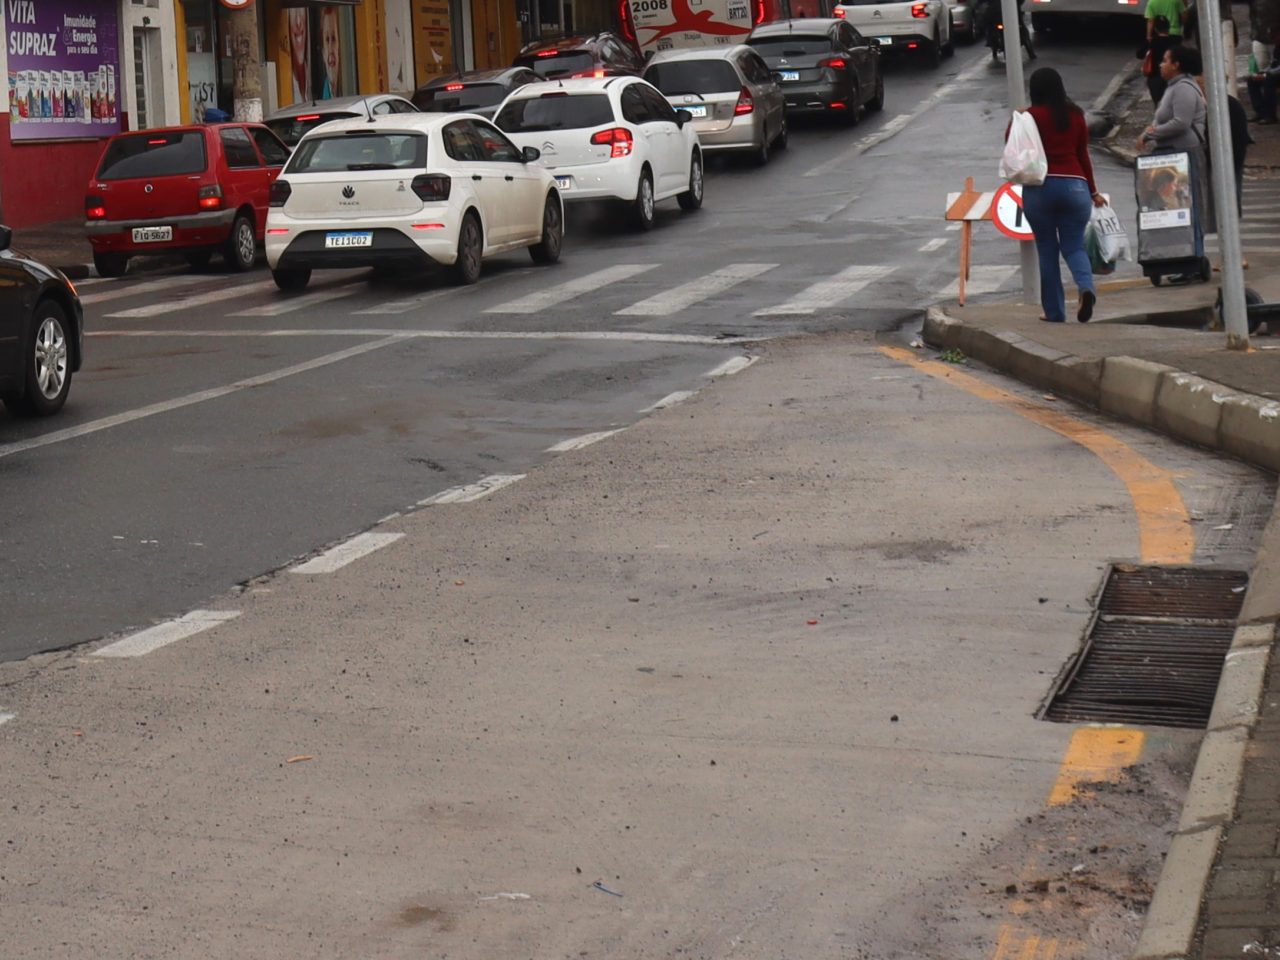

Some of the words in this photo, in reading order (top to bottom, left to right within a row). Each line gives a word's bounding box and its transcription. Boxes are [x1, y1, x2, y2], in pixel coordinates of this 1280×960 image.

[9, 0, 36, 25] VITA
[632, 0, 668, 13] 2008
[63, 14, 96, 28] Imunidade
[9, 30, 57, 56] SUPRAZ
[72, 29, 97, 46] Energia
